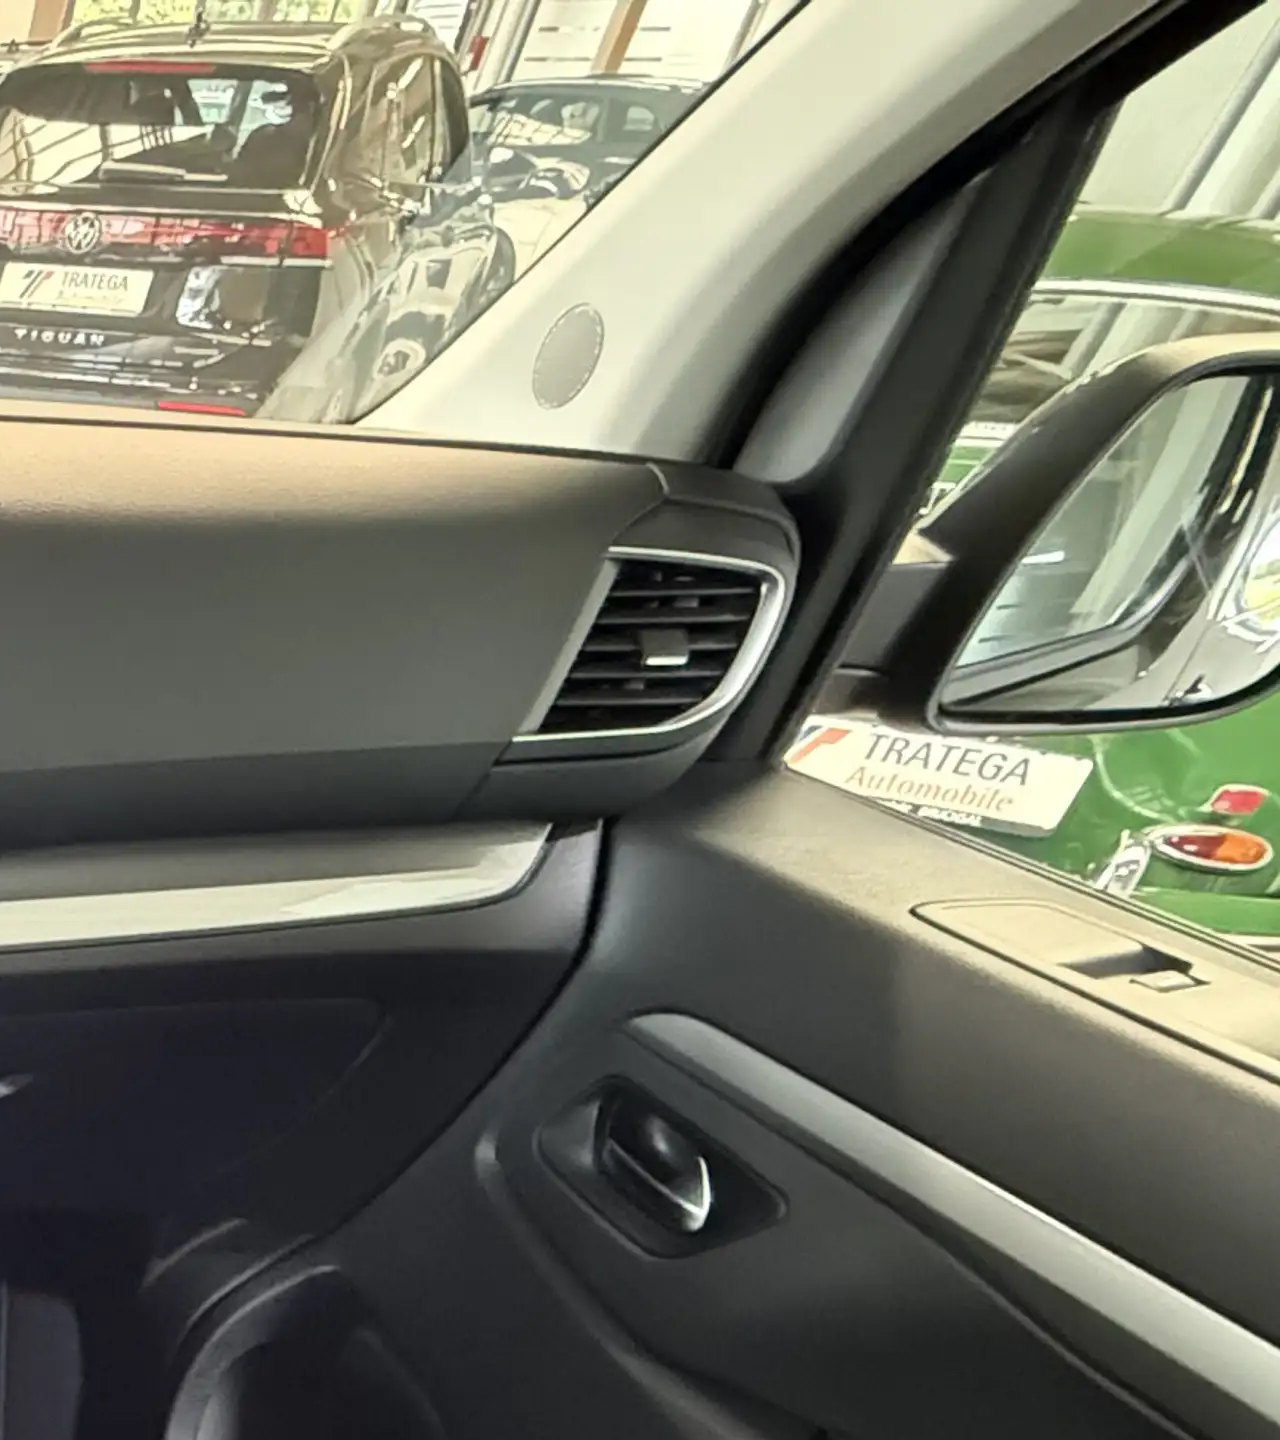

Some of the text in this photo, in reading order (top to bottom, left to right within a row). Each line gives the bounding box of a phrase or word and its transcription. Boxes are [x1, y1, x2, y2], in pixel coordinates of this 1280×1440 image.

[62, 271, 128, 292] TRATEGA
[14, 328, 105, 346] TIGUAN
[864, 733, 1030, 786] TRATEGA
[845, 766, 1014, 812] Automobile
